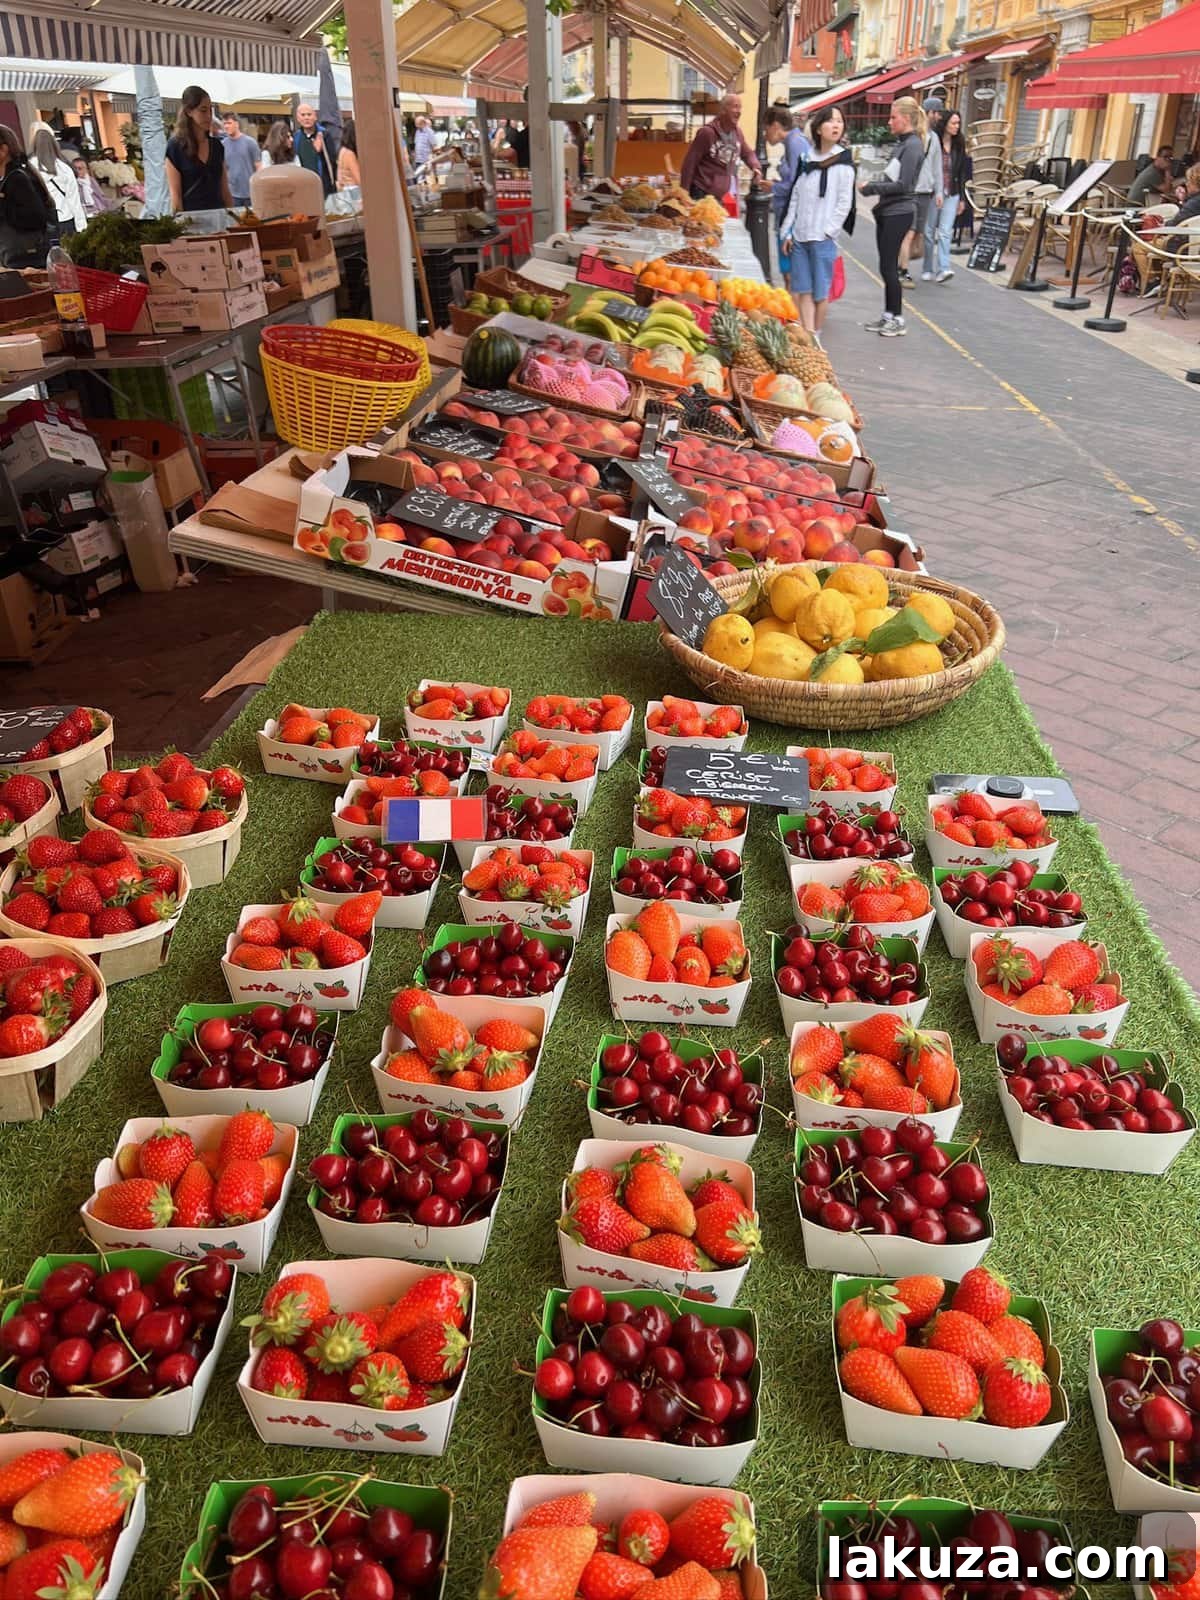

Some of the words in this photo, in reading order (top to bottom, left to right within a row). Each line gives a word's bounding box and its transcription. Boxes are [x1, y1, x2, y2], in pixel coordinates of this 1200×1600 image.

[403, 549, 511, 586] ORTOFRUTTA
[706, 752, 735, 770] 5
[740, 754, 768, 765] €
